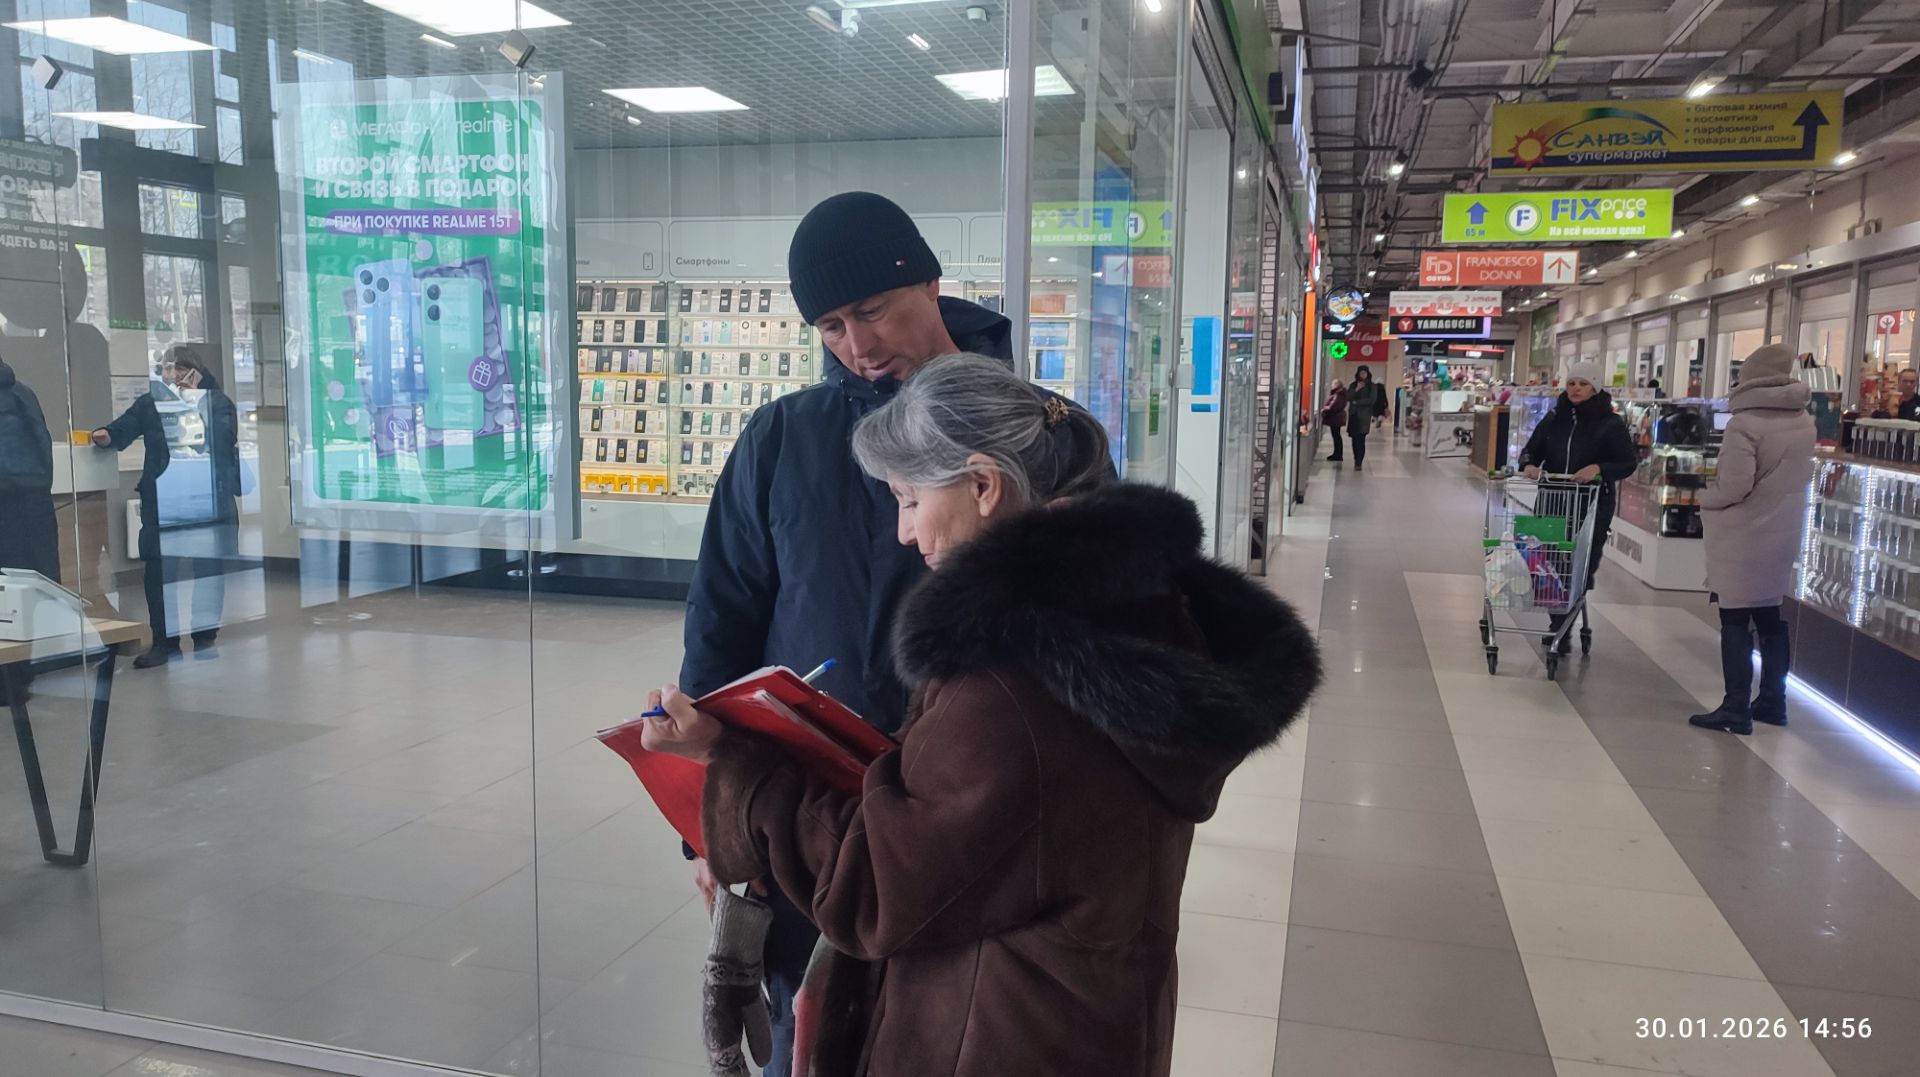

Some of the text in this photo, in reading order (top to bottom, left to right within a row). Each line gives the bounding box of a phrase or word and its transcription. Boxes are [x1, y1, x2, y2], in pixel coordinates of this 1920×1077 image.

[1694, 101, 1788, 113] бытовая химия
[457, 116, 513, 134] realme
[1693, 114, 1759, 124] косметика
[1693, 124, 1775, 135] парфюмерия
[1692, 134, 1796, 146] товары для дома
[315, 149, 530, 176] ВТОРОЙ СМАРТФОН
[1567, 149, 1669, 164] супермаркет
[315, 177, 533, 199] И СВЯЗЬ В ПОДАРОК
[334, 215, 362, 228] ПРИ
[365, 215, 430, 228] ПОКУПКЕ
[432, 215, 487, 228] REALME
[1549, 225, 1563, 236] На
[675, 256, 731, 267] Смартфоны
[1465, 255, 1538, 268] FRANCESCO
[1479, 269, 1522, 281] DONNI
[1416, 319, 1477, 330] YAMAGUCHI
